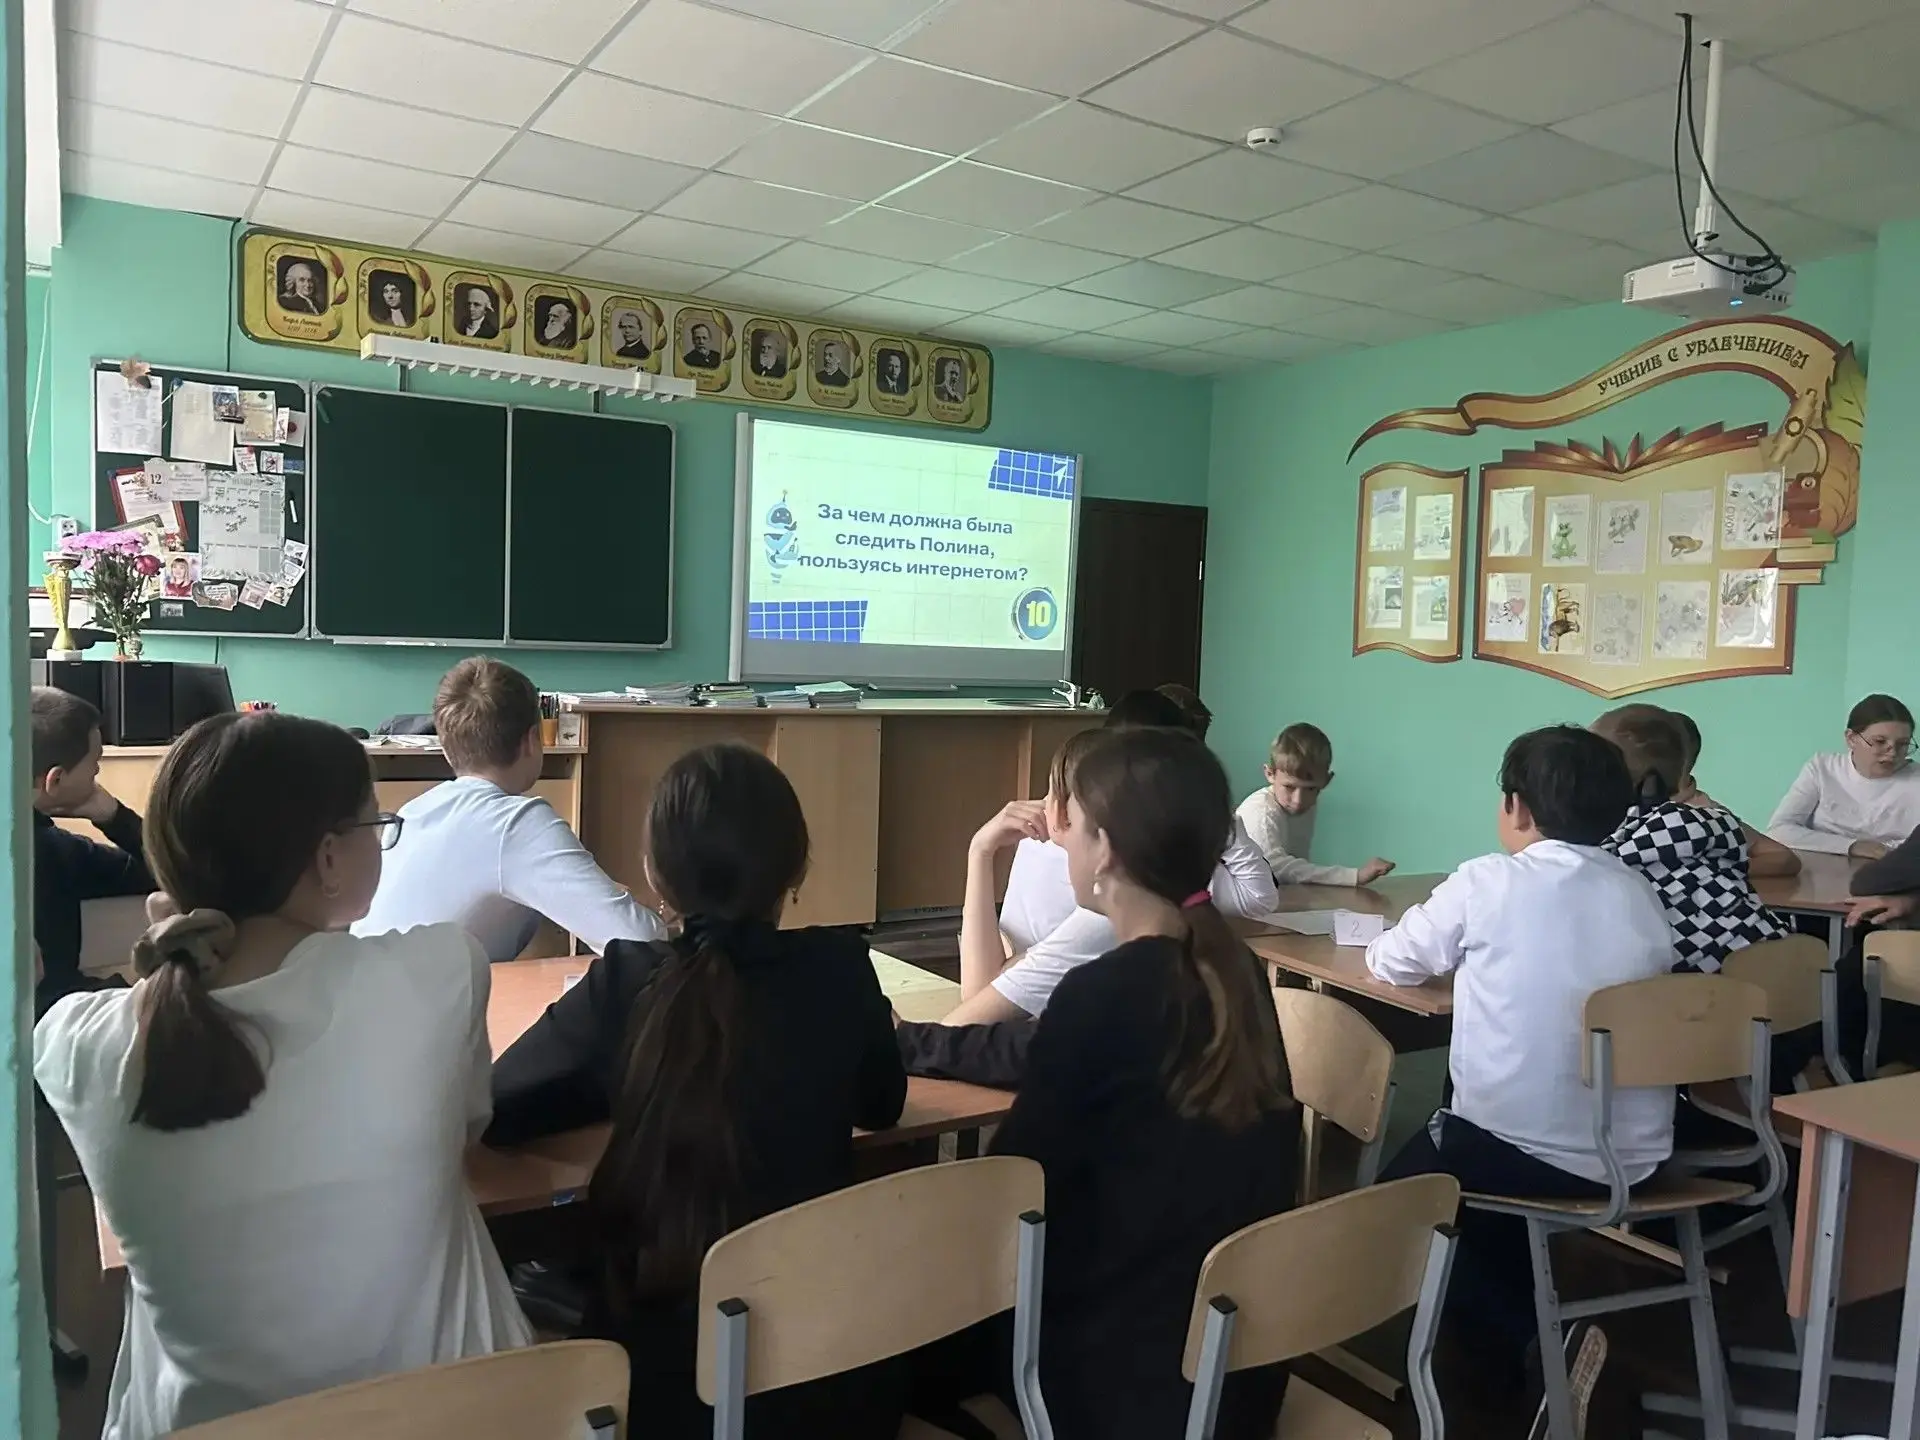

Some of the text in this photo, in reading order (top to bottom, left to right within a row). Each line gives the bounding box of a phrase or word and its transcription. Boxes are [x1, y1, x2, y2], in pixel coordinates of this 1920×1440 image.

[1597, 335, 1810, 395] УЧЕНИЕ С УВЛЕЧЕНИЕМ
[149, 473, 162, 485] 12
[817, 503, 1013, 534] За чем должна была
[835, 532, 995, 559] следить Полина,
[799, 555, 1029, 581] пользуясь интернетом?
[1026, 600, 1051, 627] 10
